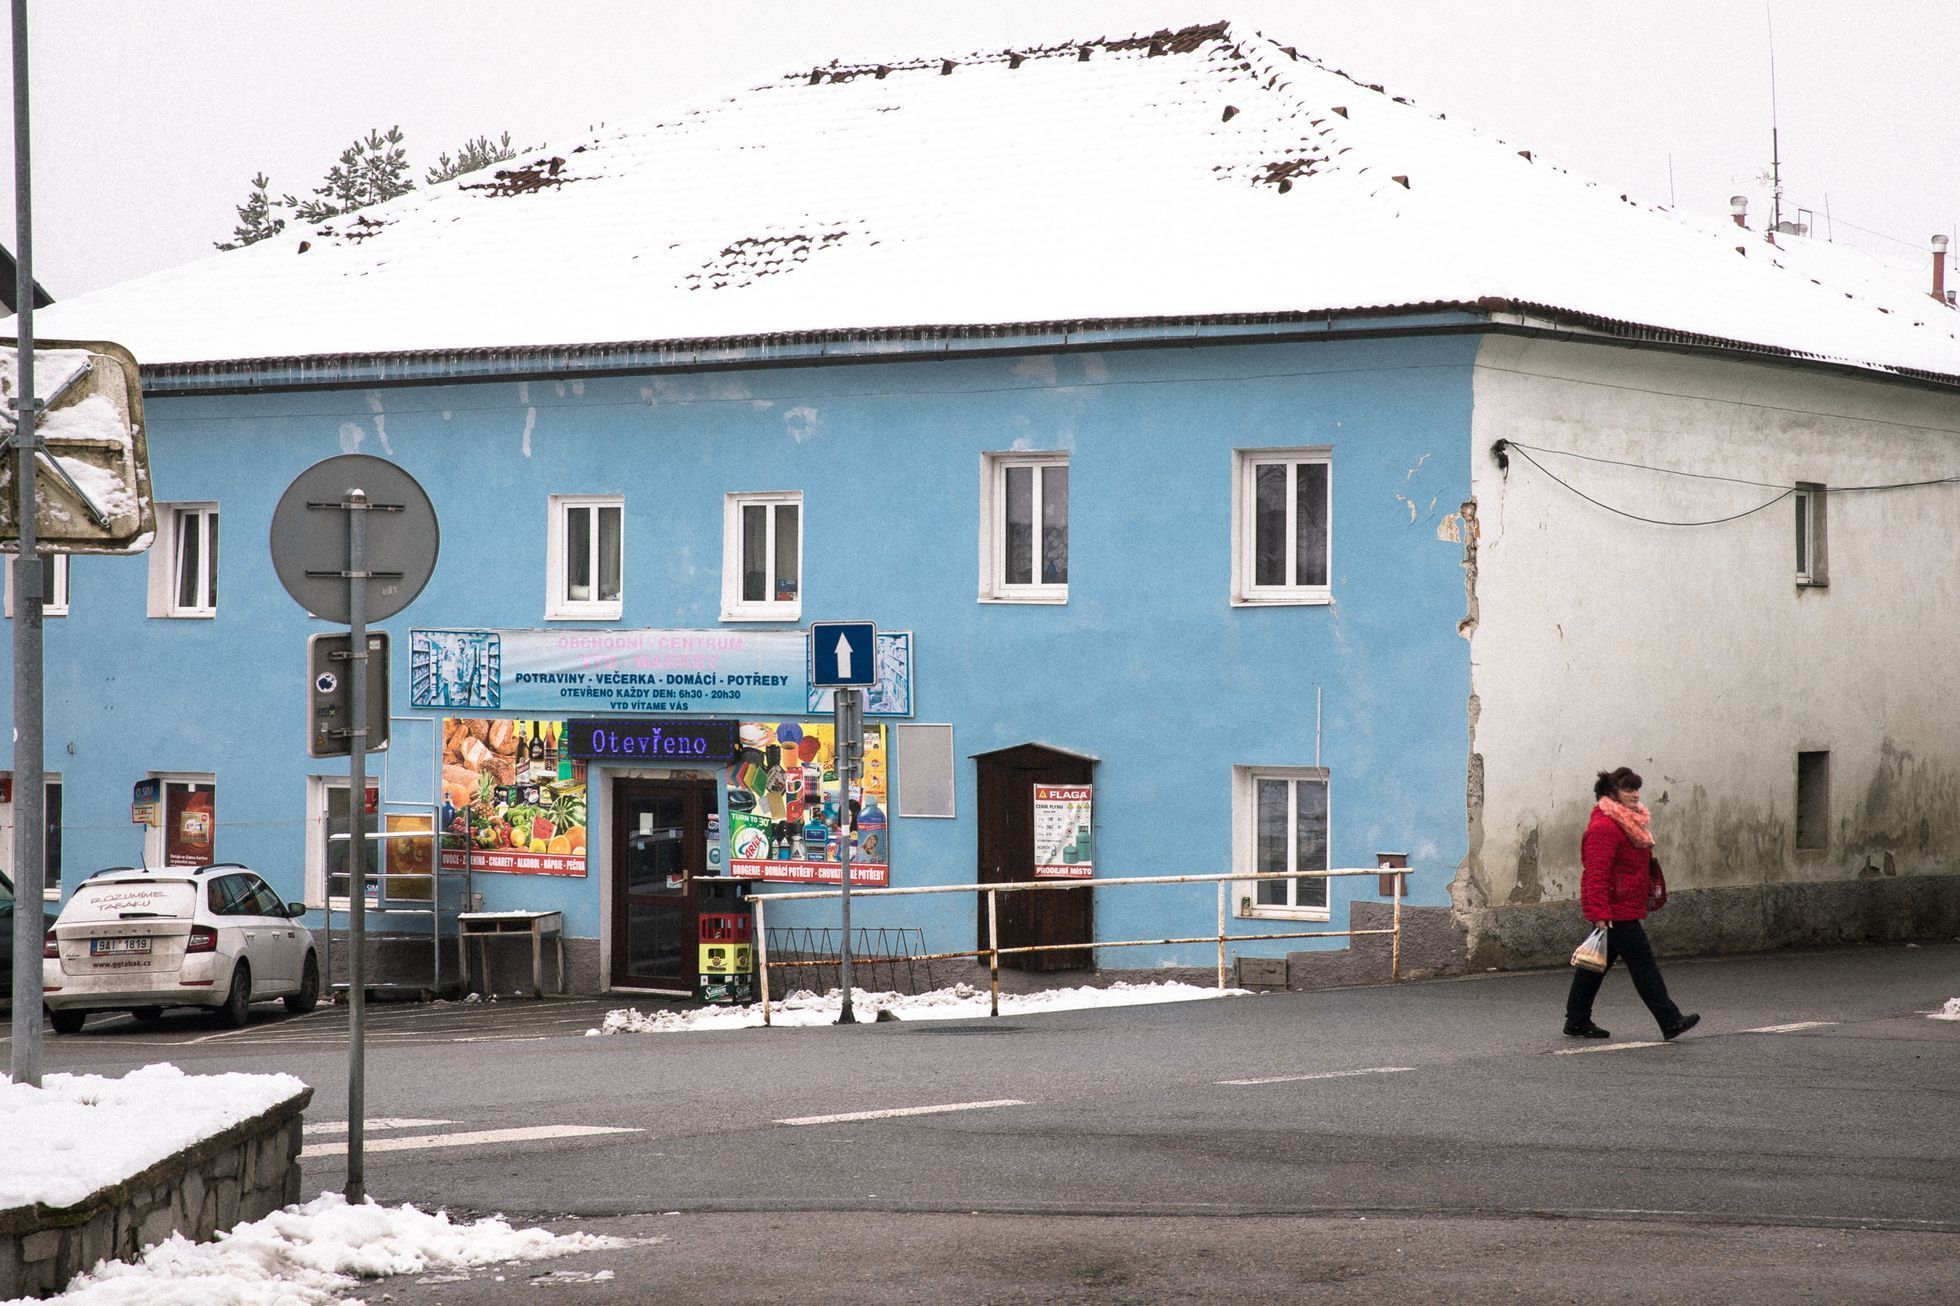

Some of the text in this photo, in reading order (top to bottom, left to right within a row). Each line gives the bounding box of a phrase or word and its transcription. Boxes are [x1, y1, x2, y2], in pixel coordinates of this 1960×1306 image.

[658, 636, 744, 651] CENTRUM
[515, 673, 585, 684] POTRAVINY
[596, 671, 656, 685] VEČERKA
[666, 672, 716, 686] DOMÁCÍ
[727, 672, 788, 686] POTŘEBY
[560, 685, 613, 698] OTEVŘENO
[652, 689, 676, 698] DEN:
[679, 689, 703, 699] 6h30
[711, 689, 741, 699] 20h30
[610, 700, 689, 711] VTD VÍTAME VÁS
[592, 727, 707, 754] Otevřeno
[1049, 790, 1087, 799] FLAGA
[731, 813, 749, 821] TURN
[745, 835, 762, 859] ARIEL
[732, 864, 761, 876] DROGERIE
[764, 865, 788, 877] DOMÁCÍ
[788, 865, 815, 878] POTŘEBY
[858, 868, 885, 881] POTŘEBY
[1036, 866, 1092, 875] PRODEJNÍ MÍSTO
[124, 940, 147, 949] 1819
[93, 960, 152, 968] www.ggtabak.cz
